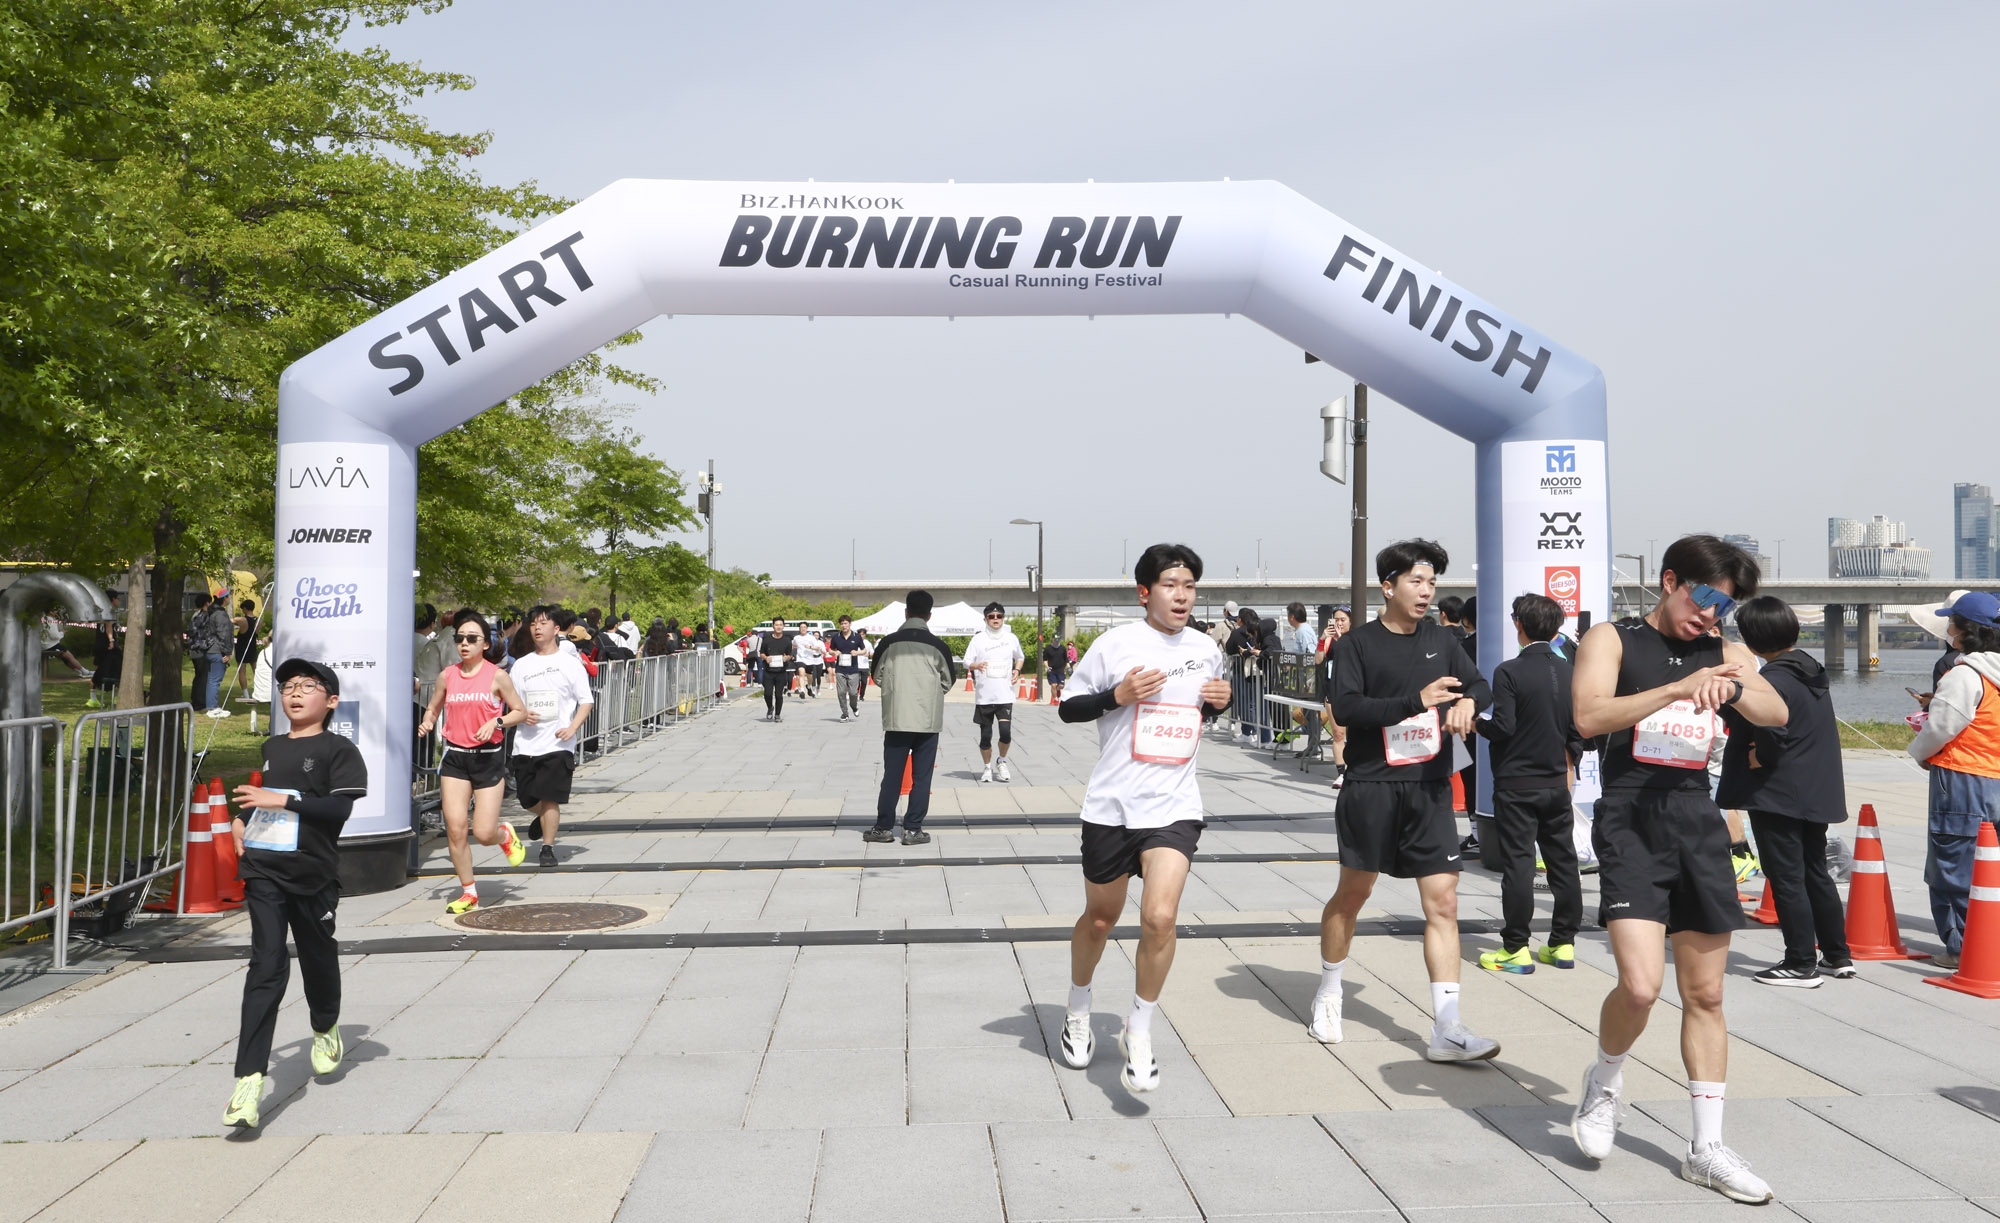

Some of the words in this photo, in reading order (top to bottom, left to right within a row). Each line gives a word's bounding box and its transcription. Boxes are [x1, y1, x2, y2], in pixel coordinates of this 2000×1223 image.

[719, 215, 1022, 270] BURNING
[1033, 215, 1183, 269] RUN
[949, 273, 1009, 288] Casual
[1015, 273, 1089, 290] Running
[1095, 272, 1163, 287] Festival
[368, 230, 594, 397] START
[1322, 234, 1552, 395] FINISH
[1540, 476, 1582, 487] MOOTO
[1549, 487, 1574, 496] TEAMS
[287, 528, 373, 544] JOHNBER
[1537, 538, 1586, 550] REXY
[295, 577, 358, 598] Choco
[1550, 579, 1576, 589] 비타500
[291, 595, 364, 620] Health
[1185, 659, 1204, 672] Run
[533, 700, 555, 708] 5046
[1142, 725, 1152, 734] M
[1153, 724, 1194, 740] 2429
[1391, 733, 1400, 742] M
[1402, 727, 1433, 742] 1752
[1646, 721, 1658, 731] M
[1661, 721, 1706, 740] 1083
[1641, 745, 1662, 755] D-71
